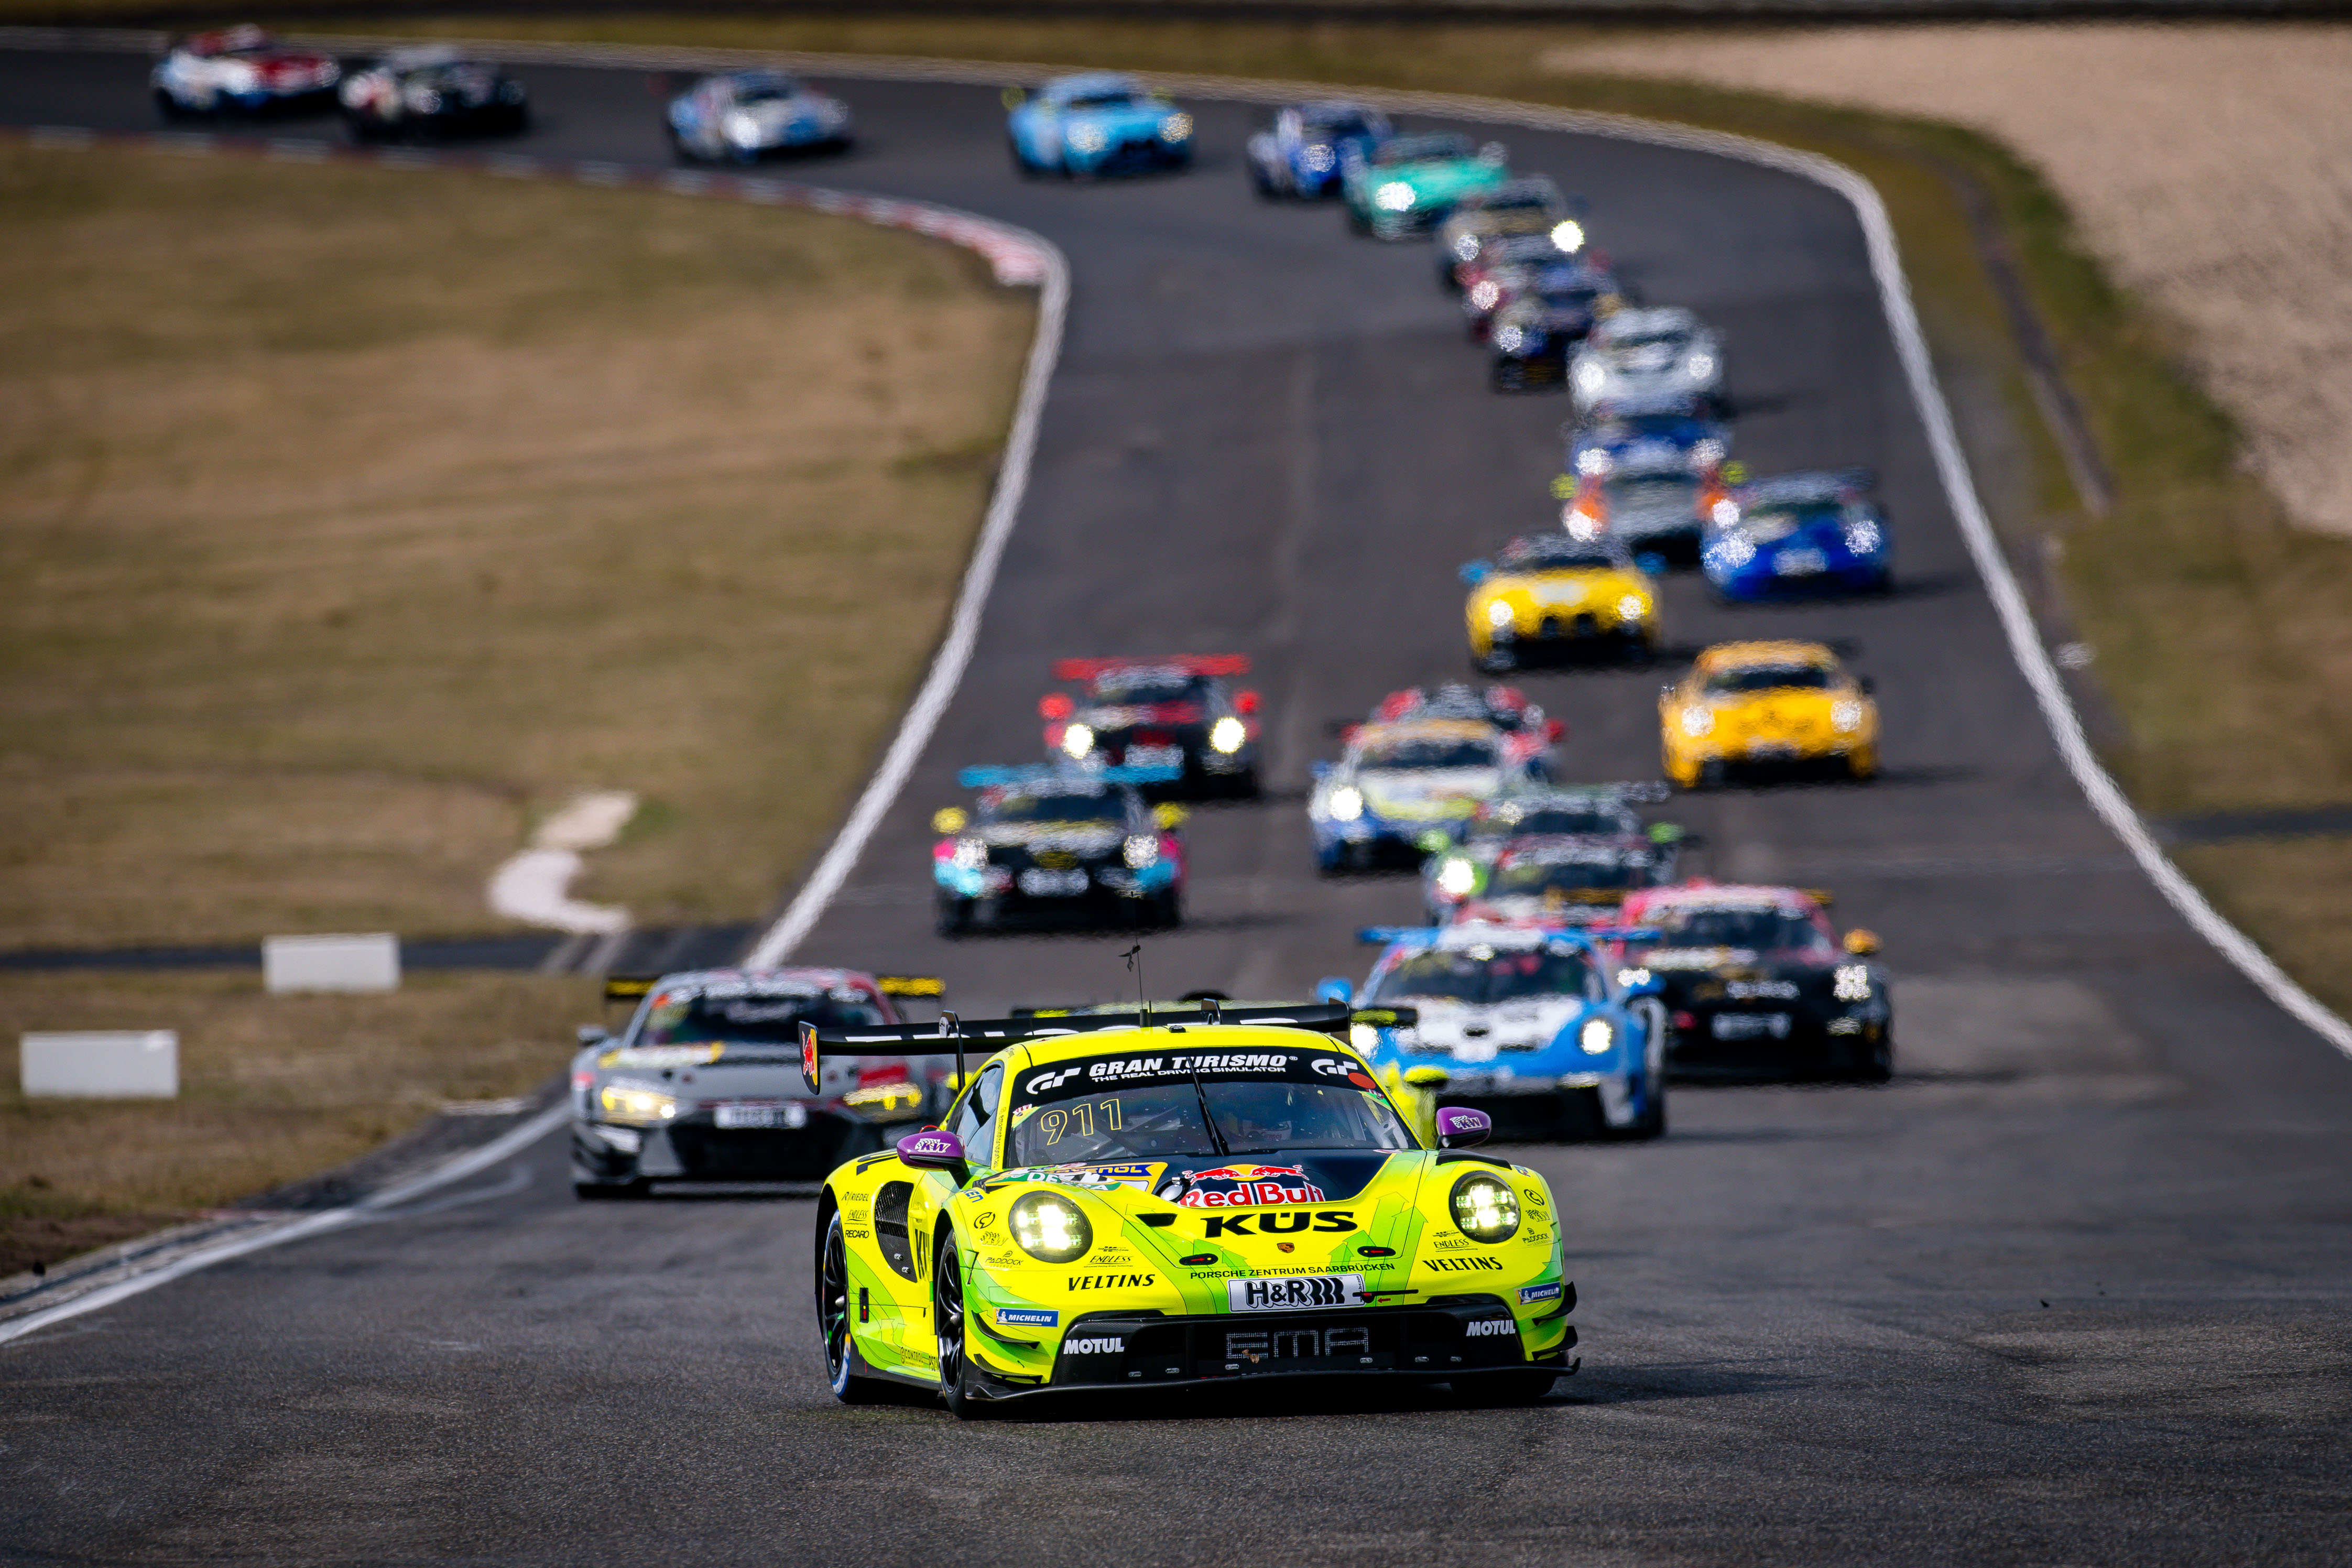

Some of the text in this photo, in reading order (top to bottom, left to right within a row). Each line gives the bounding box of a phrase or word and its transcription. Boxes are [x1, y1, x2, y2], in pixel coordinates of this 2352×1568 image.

[1090, 1058, 1163, 1077] GRAN
[1121, 1071, 1155, 1080] REAL
[1040, 1098, 1122, 1146] 911
[1456, 1117, 1482, 1129] KW
[918, 1141, 951, 1153] KW
[1179, 1181, 1325, 1207] Red Bull
[847, 1210, 868, 1219] ENDLESS
[1200, 1211, 1358, 1238] KÜS
[845, 1230, 869, 1238] RECARO
[1522, 1233, 1550, 1244] PADDOCK
[1433, 1238, 1469, 1248] ENDLESS
[985, 1257, 1024, 1266] PADDOCK
[1422, 1257, 1503, 1271] VELTINS
[1190, 1263, 1396, 1279] PORSCHE ZENTRUM SAARBRÜCKEN
[1069, 1274, 1156, 1291] VELTINS
[1246, 1280, 1309, 1307] H&R
[1466, 1320, 1516, 1336] MOTUL
[1063, 1338, 1125, 1355] MOTUL
[1226, 1327, 1368, 1359] EMA
